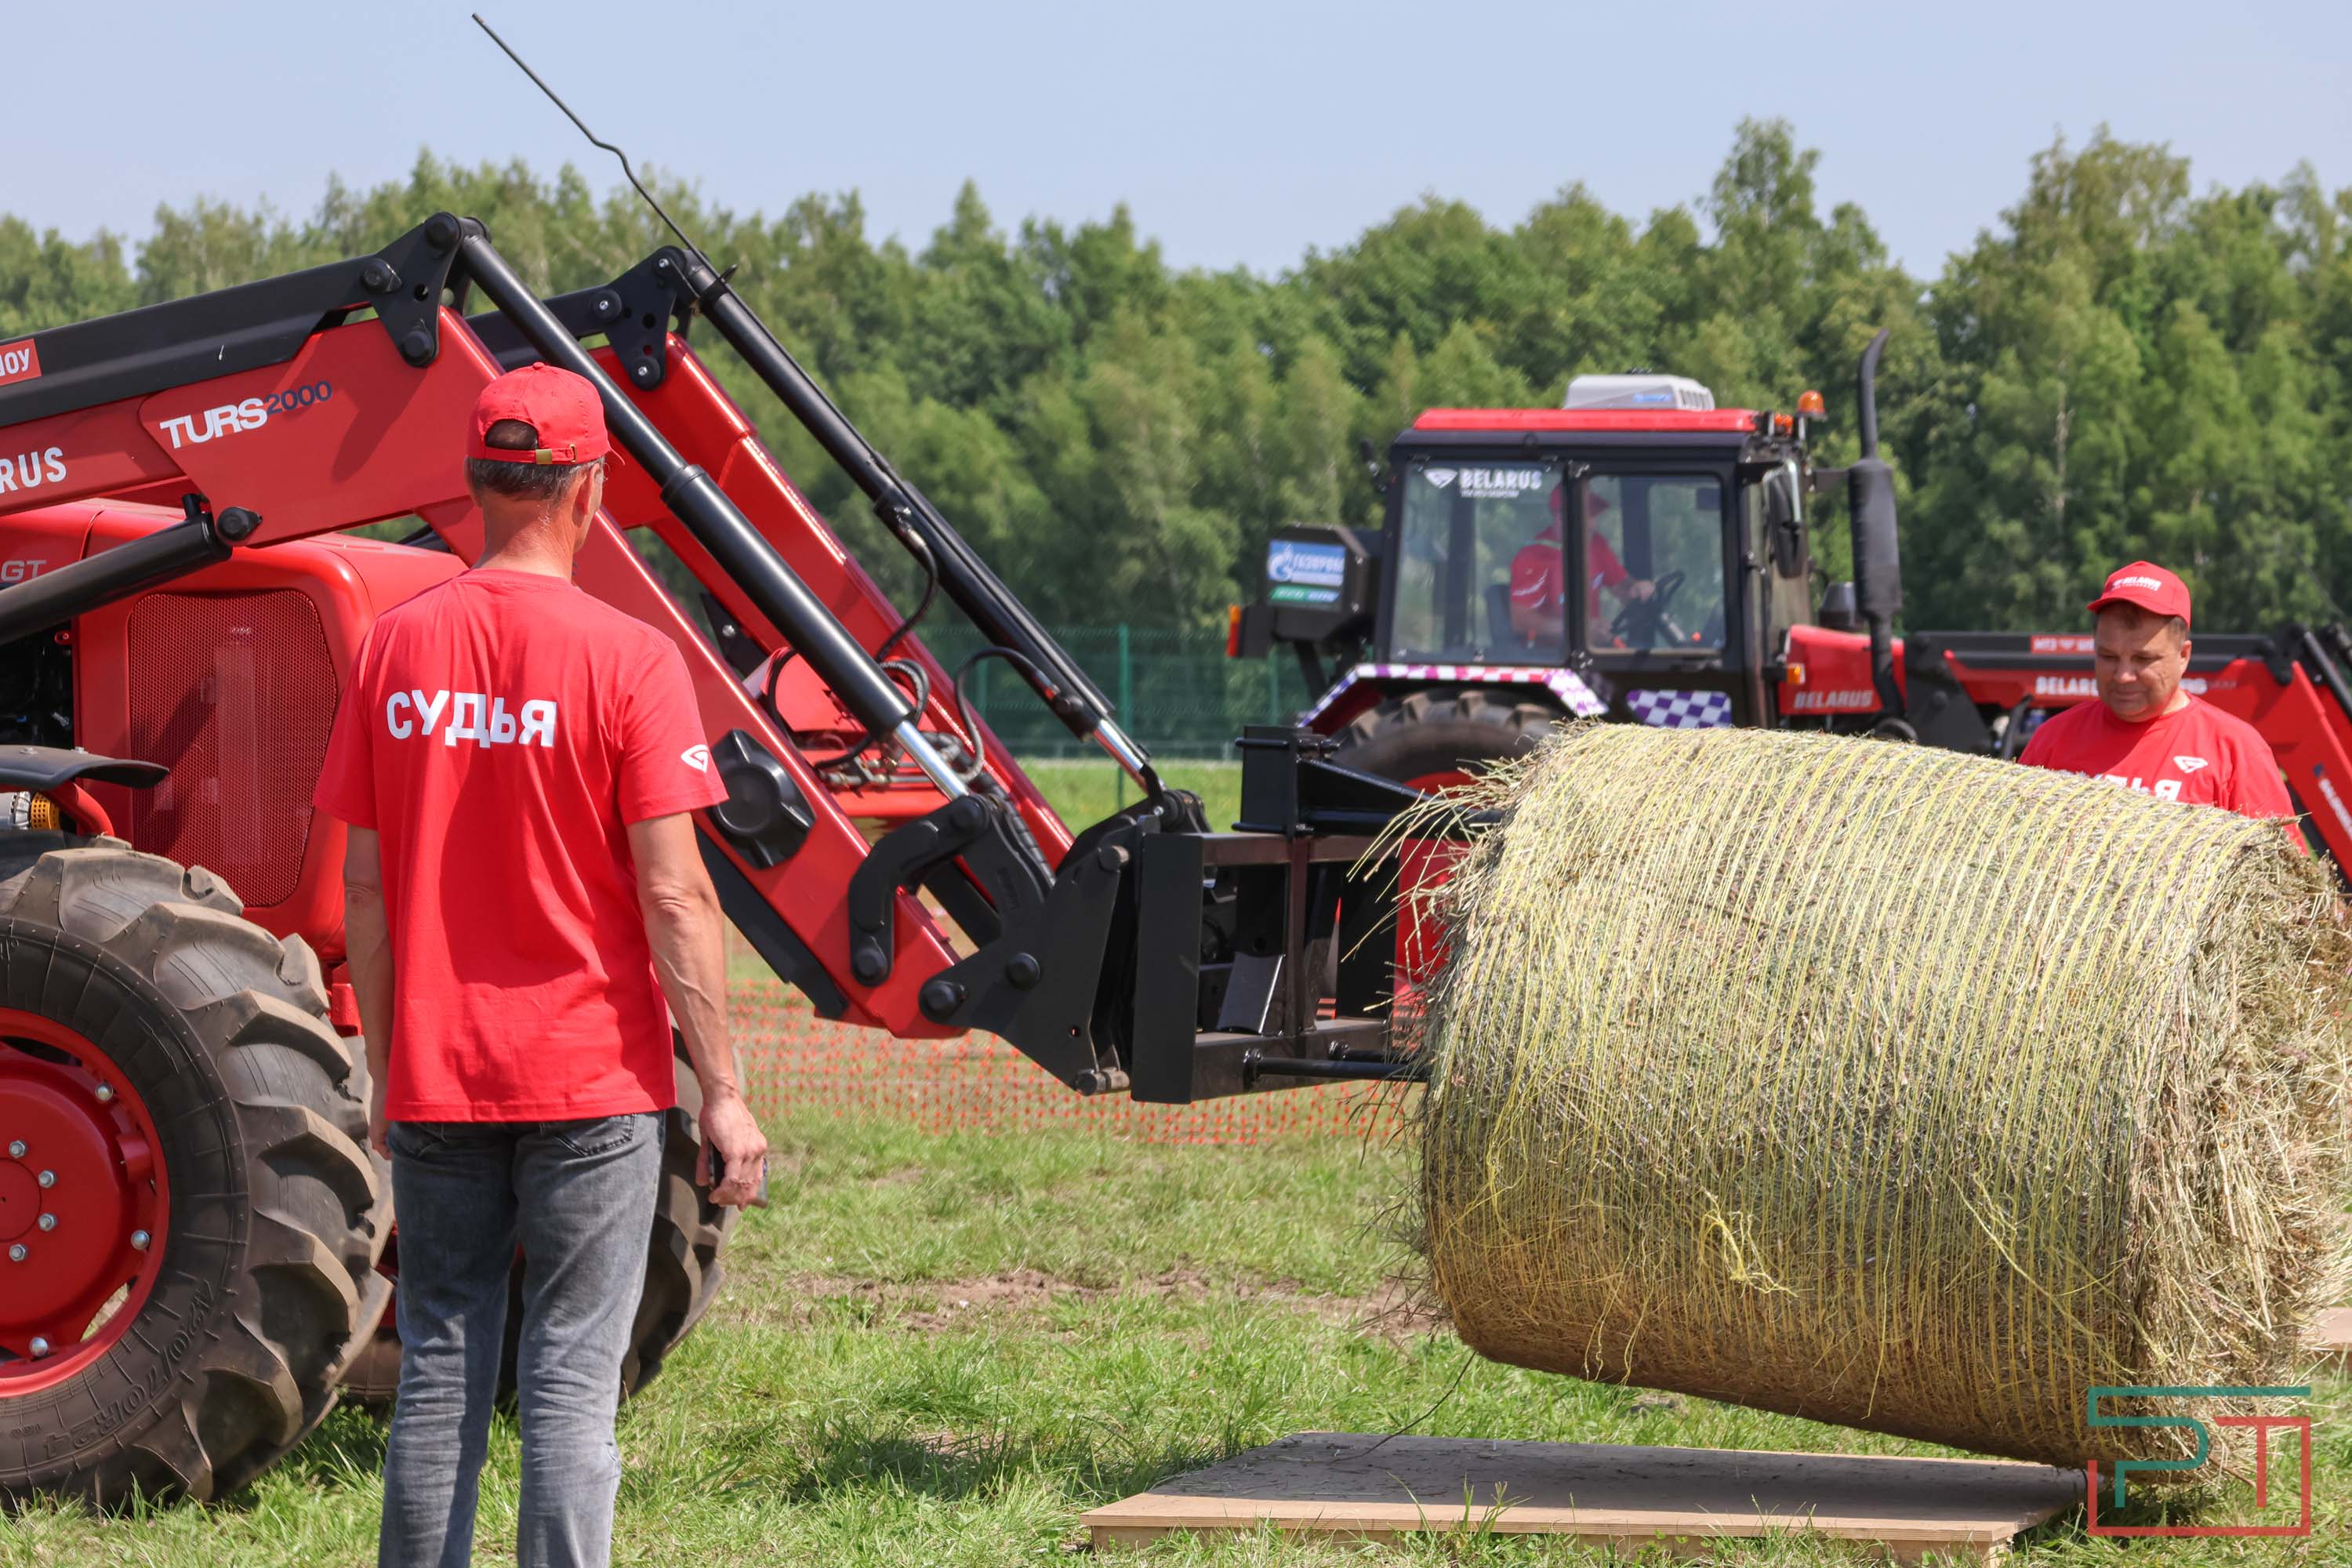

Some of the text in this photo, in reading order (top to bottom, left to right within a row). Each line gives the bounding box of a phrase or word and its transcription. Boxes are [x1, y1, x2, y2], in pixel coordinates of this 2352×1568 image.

[1461, 468, 1542, 490] BELARUS
[1794, 690, 1873, 709] BELARUS
[387, 689, 557, 749] СУДЬЯ
